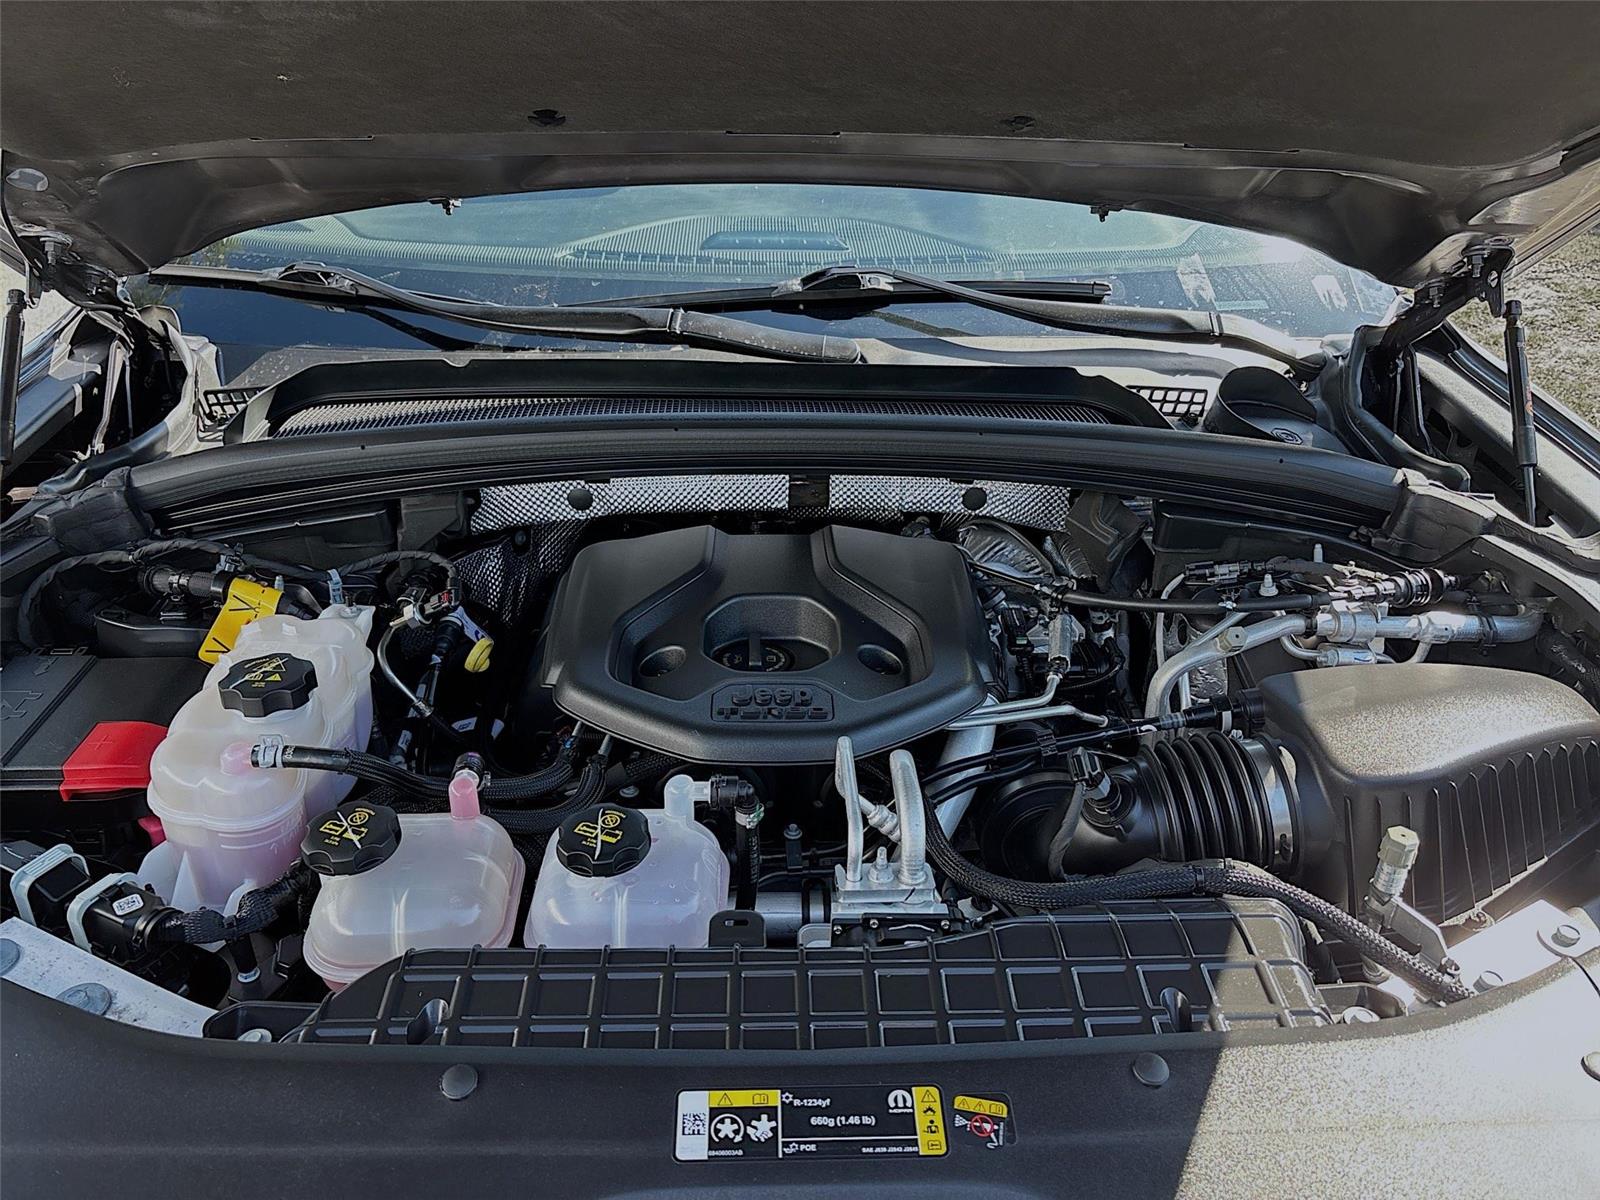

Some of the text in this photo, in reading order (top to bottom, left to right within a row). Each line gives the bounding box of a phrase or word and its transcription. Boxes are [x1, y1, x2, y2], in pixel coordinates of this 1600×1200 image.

[793, 1098, 831, 1107] R-1234yf
[810, 1115, 876, 1127] 660g (1.46 lb)
[800, 1144, 817, 1152] POE
